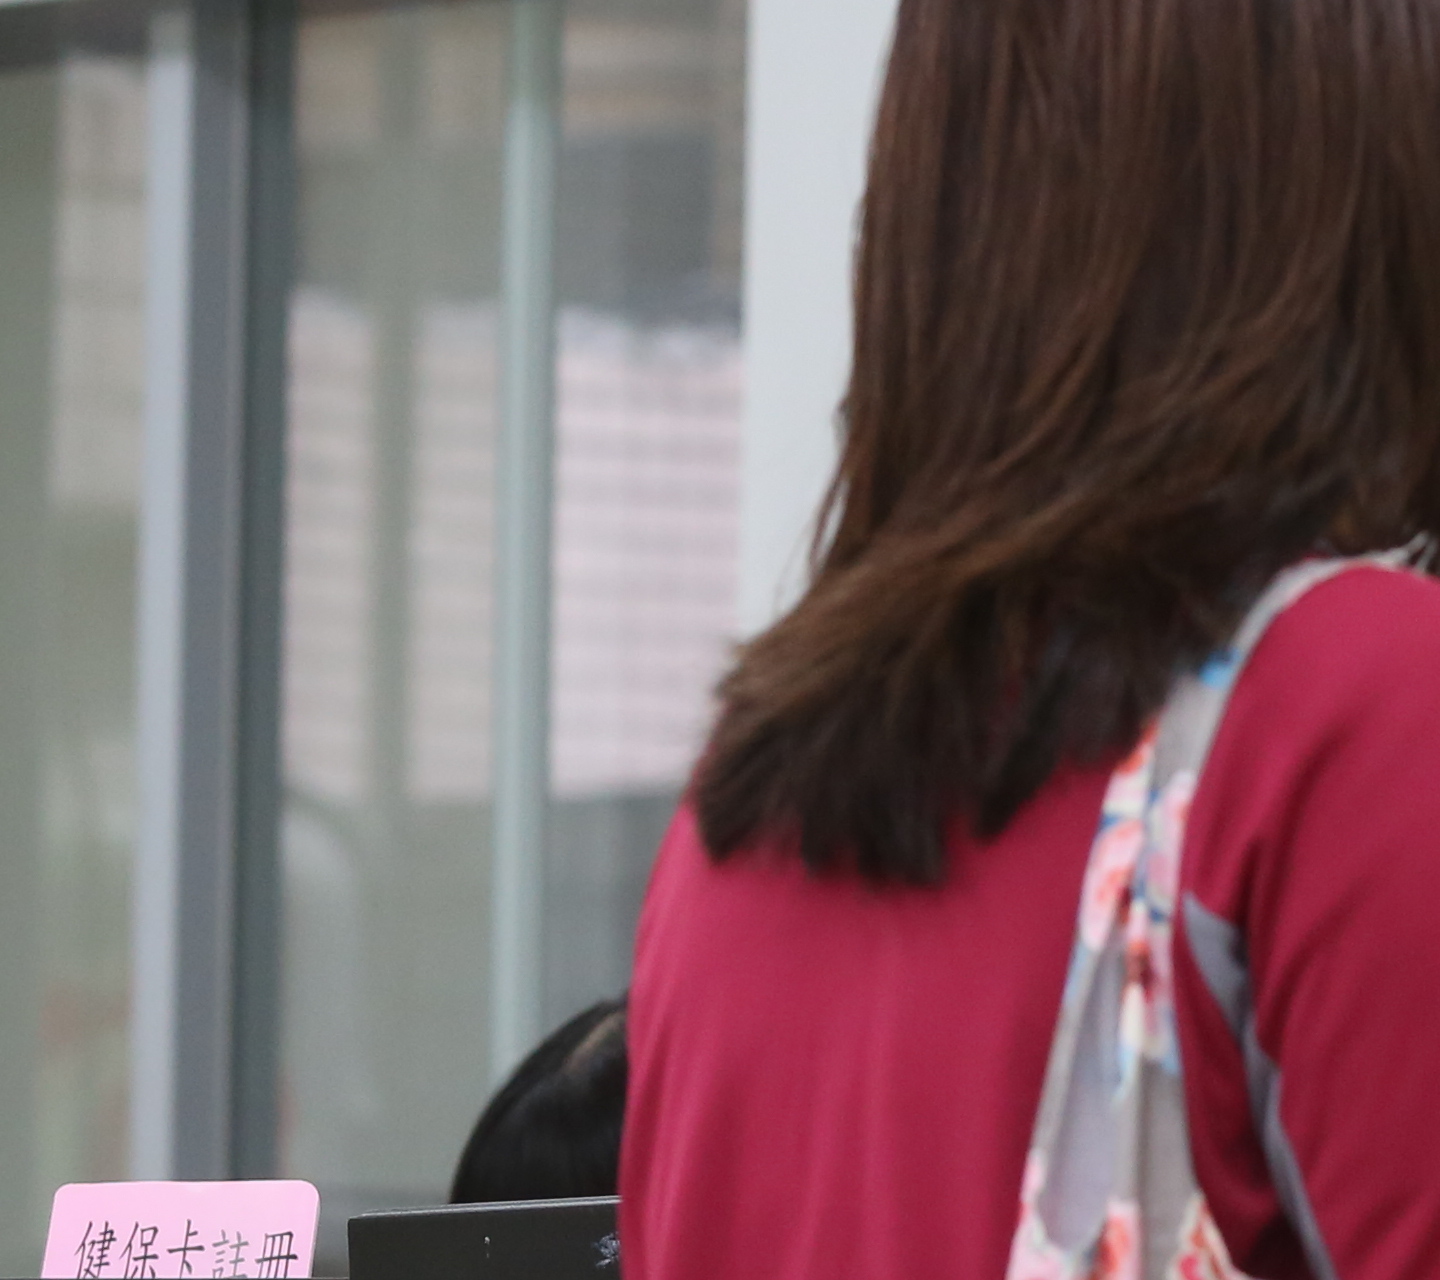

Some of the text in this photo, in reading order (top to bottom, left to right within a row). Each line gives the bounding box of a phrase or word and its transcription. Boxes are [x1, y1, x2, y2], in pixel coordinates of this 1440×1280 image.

[73, 1220, 299, 1279] 健保卡註冊
